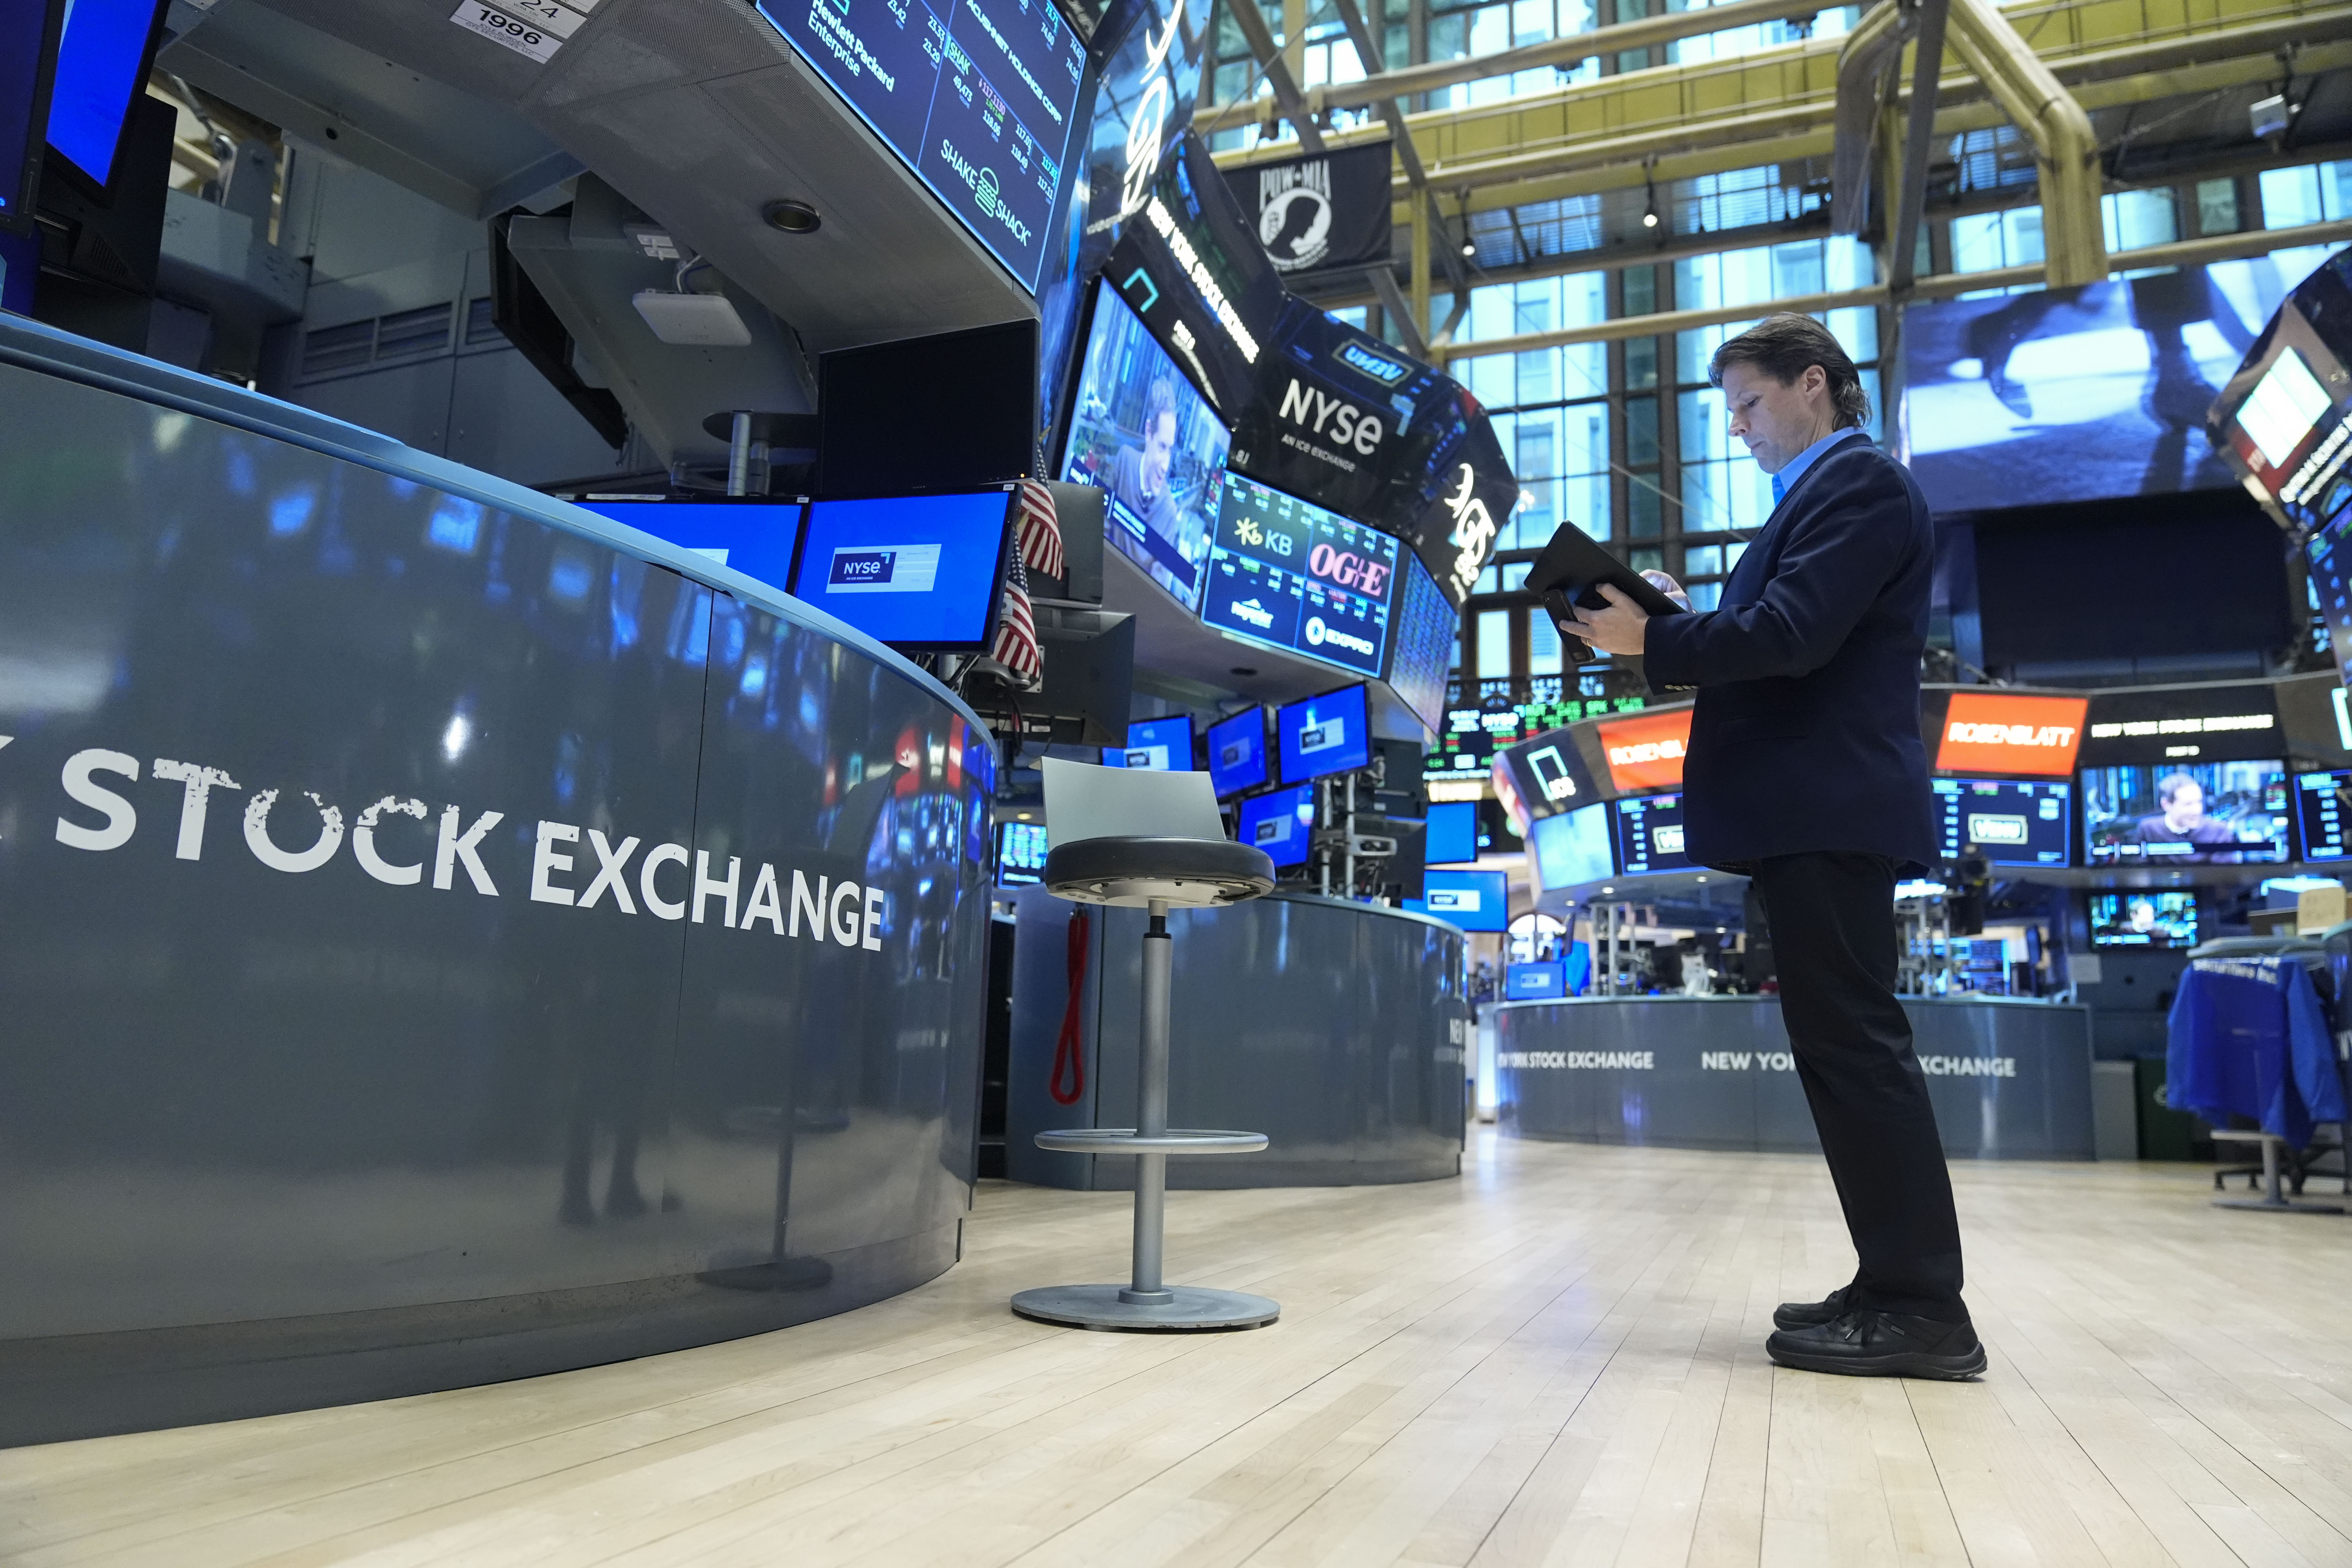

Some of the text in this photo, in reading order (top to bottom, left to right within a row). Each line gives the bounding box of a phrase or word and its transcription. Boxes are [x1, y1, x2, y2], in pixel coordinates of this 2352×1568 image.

[465, 22, 479, 30] GTS
[479, 9, 542, 45] 1996
[927, 15, 946, 41] 23.33
[966, 0, 1009, 53] ACUSHNET
[808, 10, 860, 76] Enterprise
[813, 0, 895, 92] Hewlett Packard
[923, 38, 940, 64] 23.29
[949, 42, 971, 75] SHAK
[941, 139, 1030, 246] SHAKE SHACK
[1259, 158, 1332, 213] POW MIA
[1265, 529, 1293, 556] KB
[1948, 722, 2075, 747] ROSENBLATT
[1610, 739, 1689, 765] ROSENBL
[55, 748, 505, 897] STOCK
[530, 820, 884, 951] EXCHANGE
[1528, 1051, 1567, 1069] STOCK
[1567, 1051, 1654, 1070] EXCHANGE
[1701, 1052, 1751, 1071] NEW
